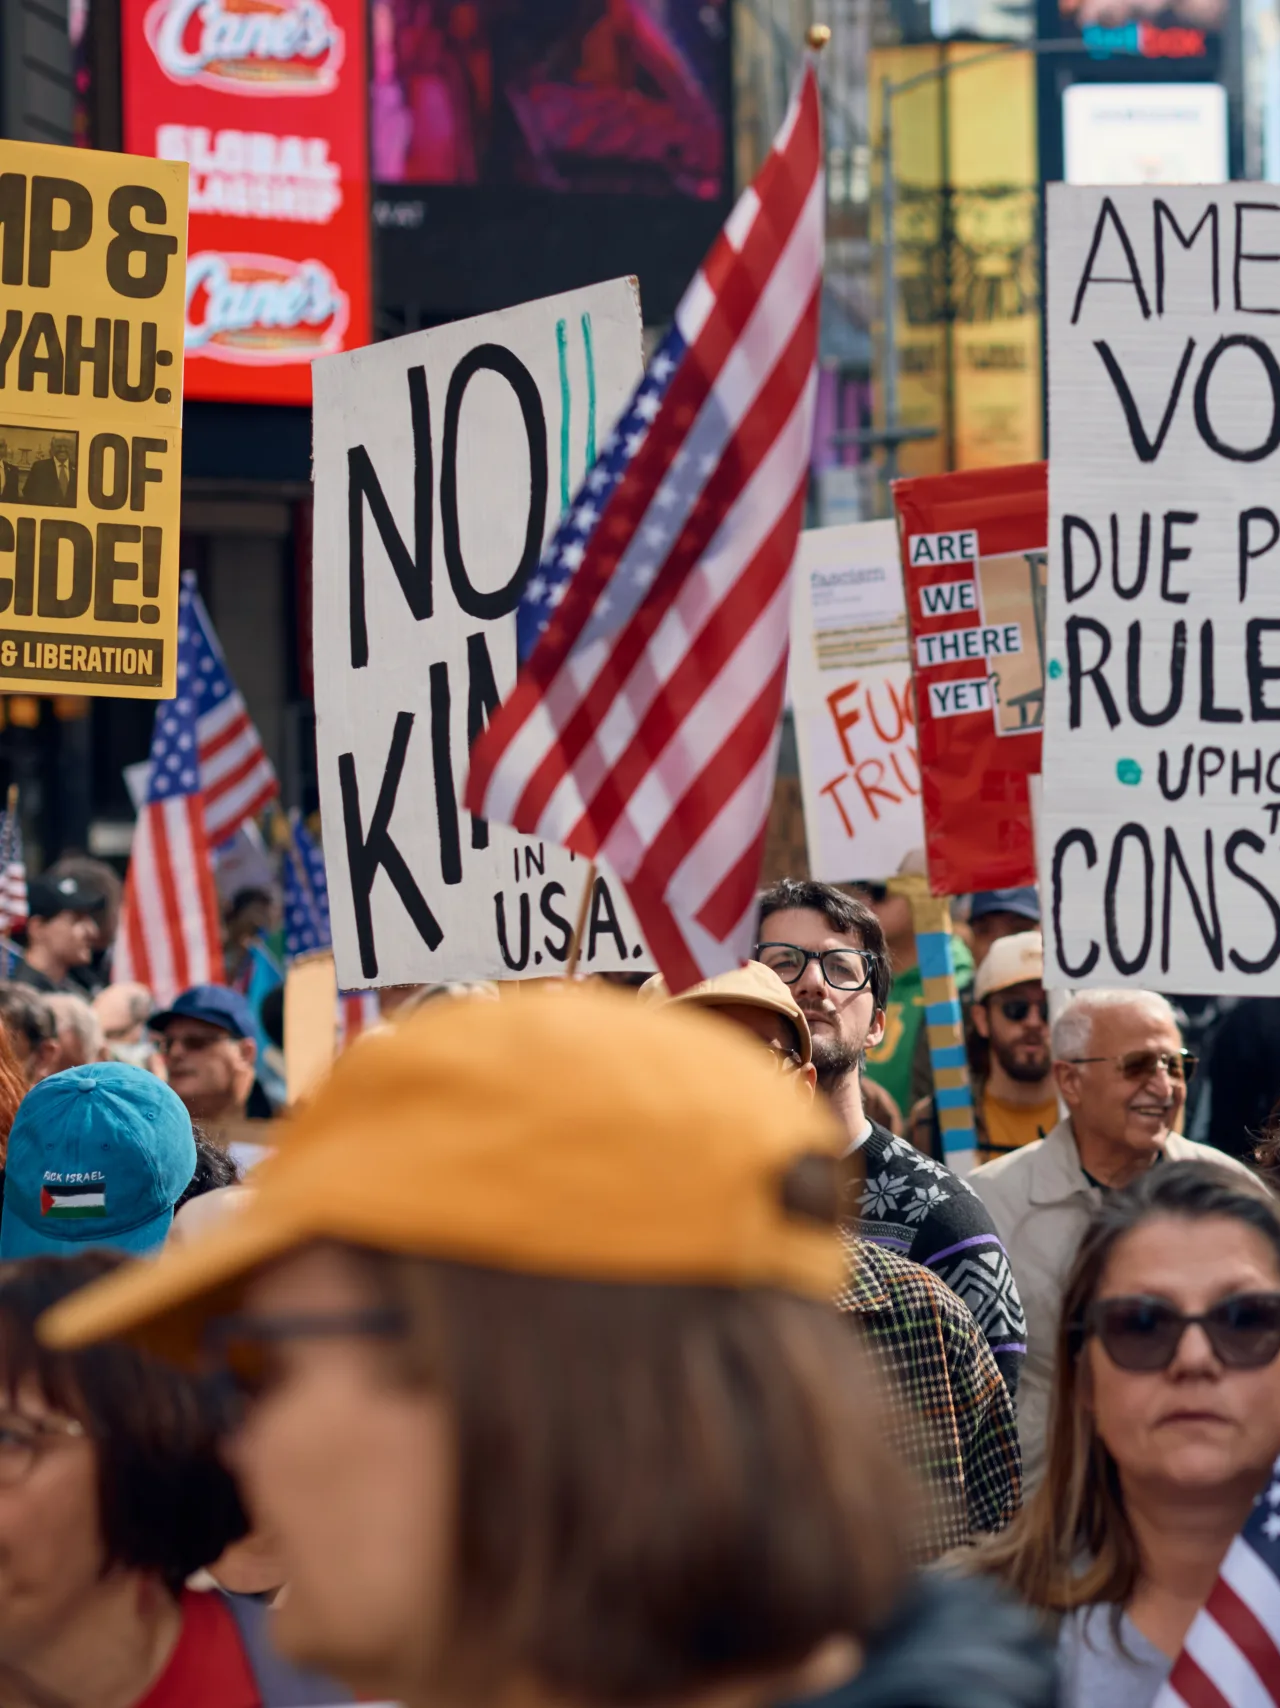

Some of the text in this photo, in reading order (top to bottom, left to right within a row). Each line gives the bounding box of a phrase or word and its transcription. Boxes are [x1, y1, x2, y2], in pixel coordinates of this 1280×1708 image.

[106, 185, 178, 299] &
[88, 433, 167, 511] OF
[913, 533, 975, 562] ARE
[1062, 510, 1199, 606] DUE
[923, 582, 975, 613] WE
[1, 640, 154, 676] & LIBERATION
[919, 626, 1020, 663] THERE
[933, 671, 1001, 712] YET?
[513, 842, 545, 883] IN
[494, 875, 644, 972] U.S.A.
[65, 1170, 105, 1184] ISRAEL
